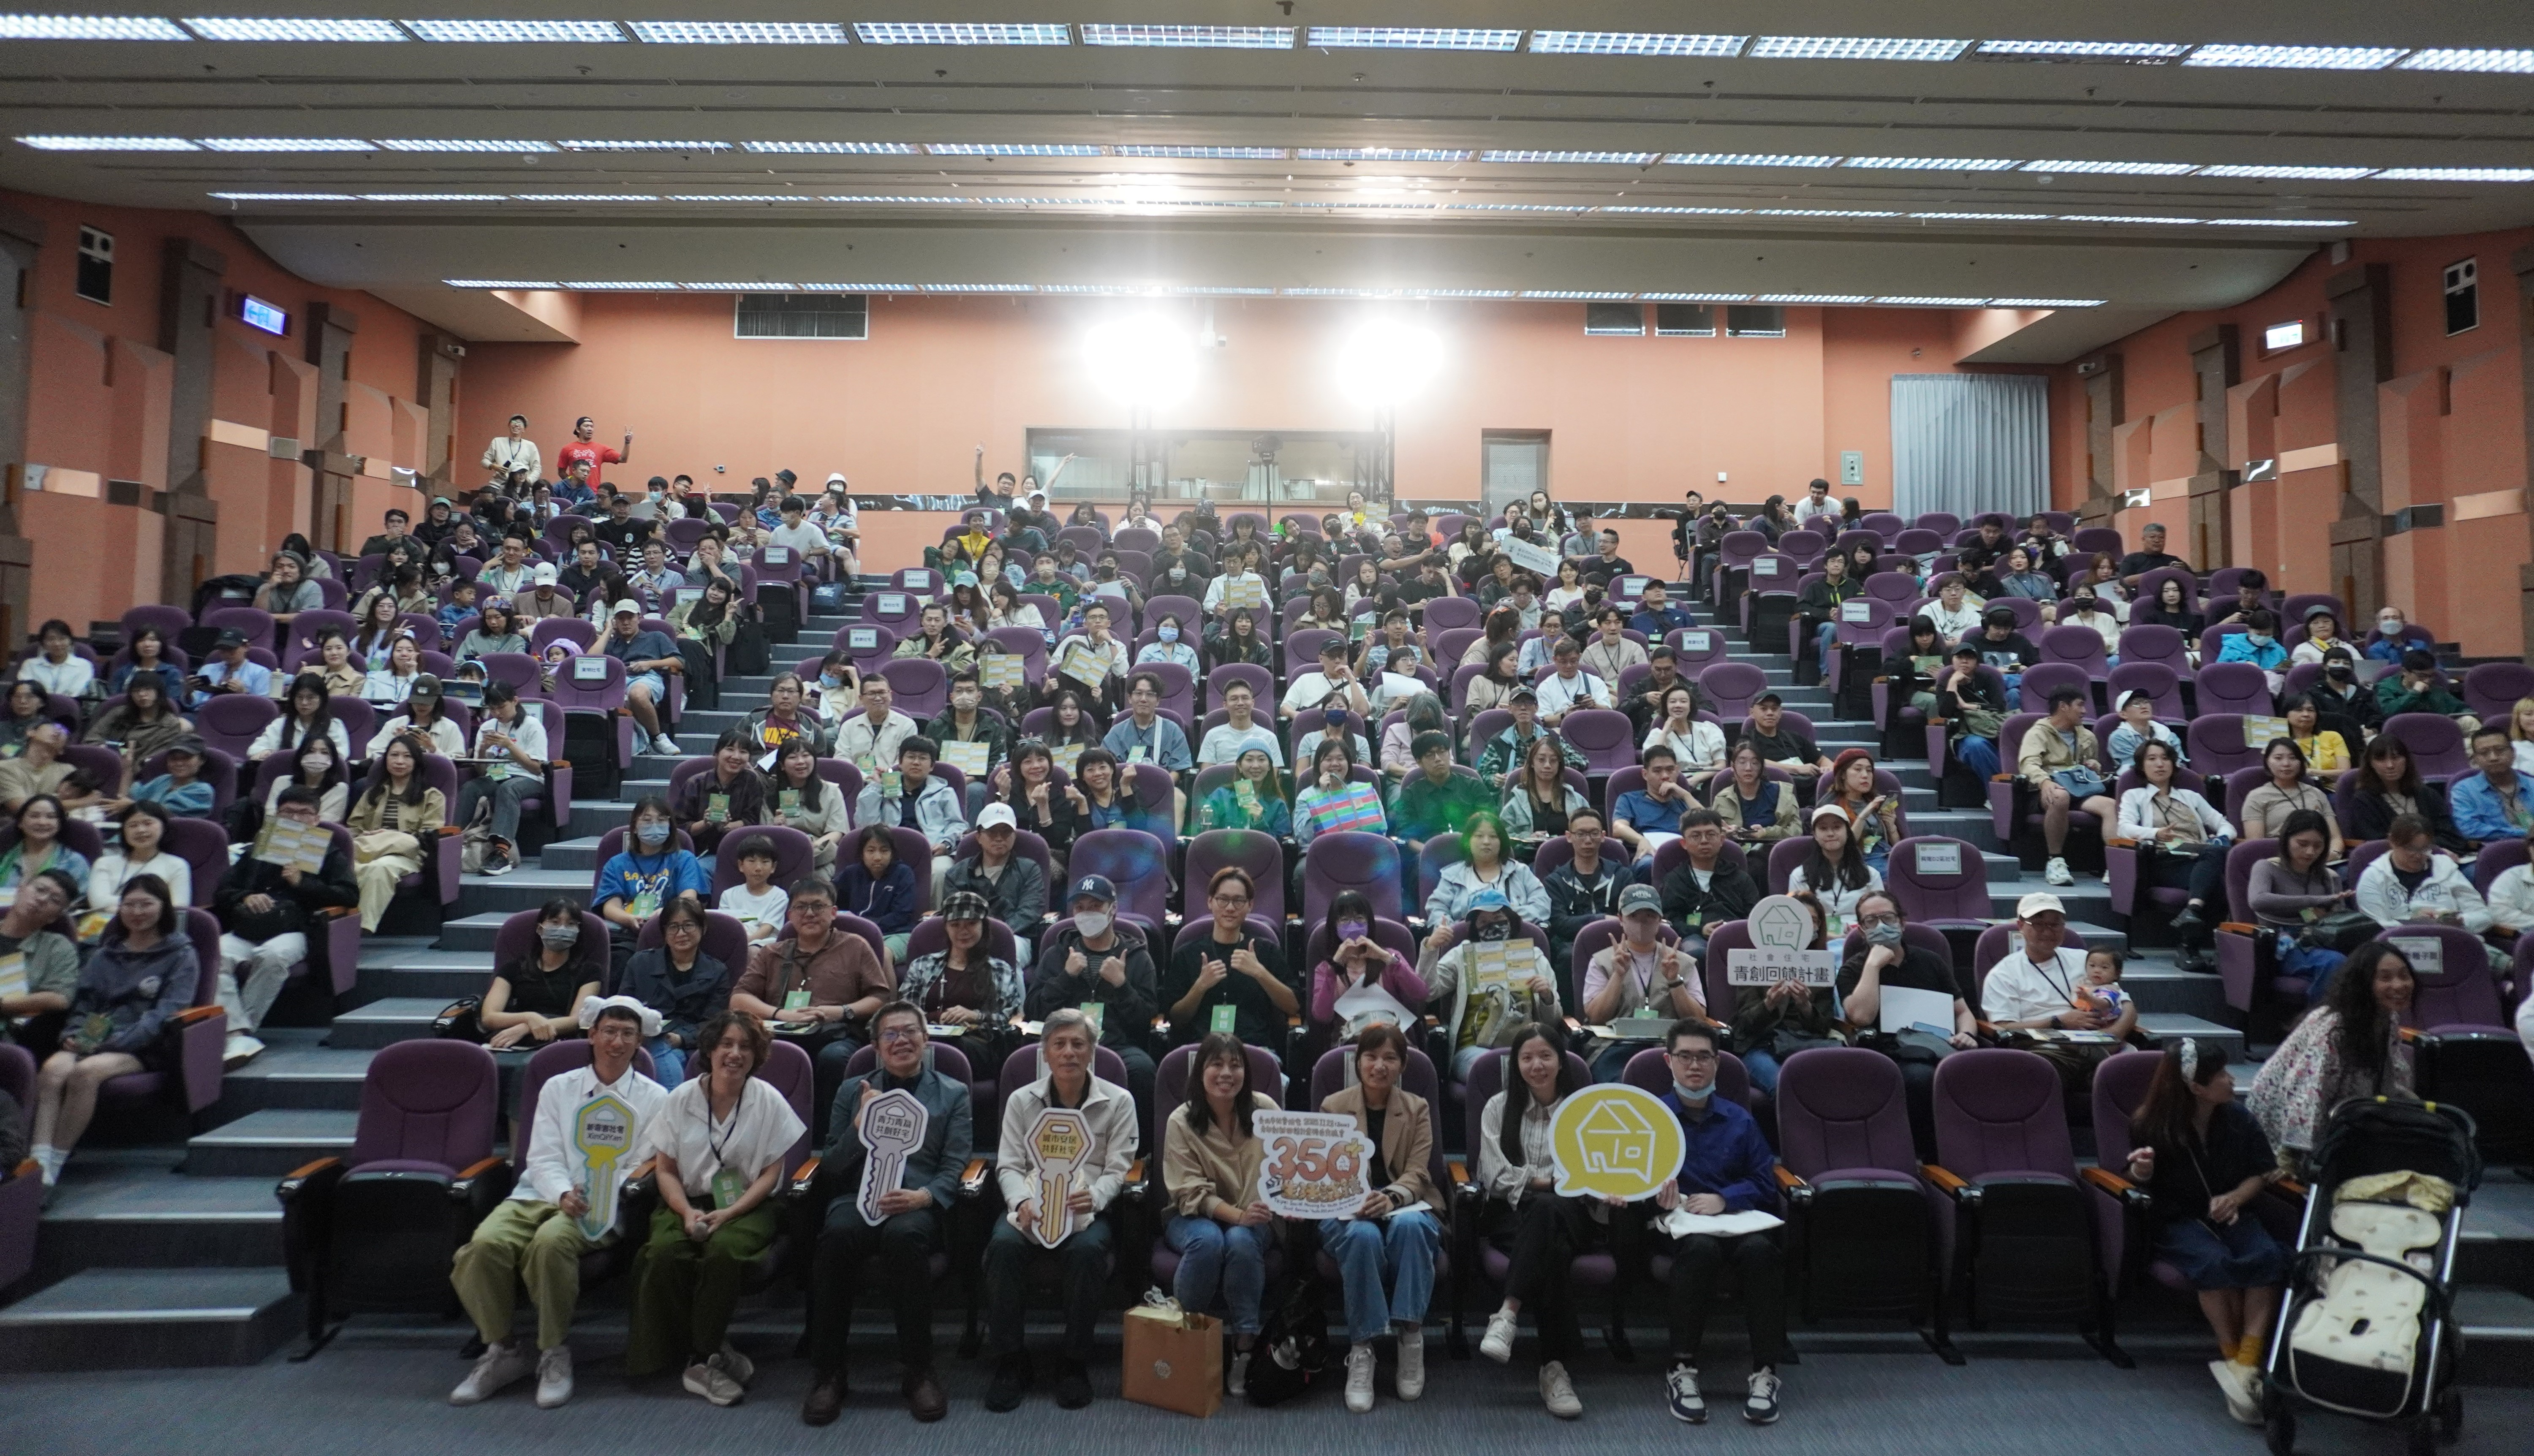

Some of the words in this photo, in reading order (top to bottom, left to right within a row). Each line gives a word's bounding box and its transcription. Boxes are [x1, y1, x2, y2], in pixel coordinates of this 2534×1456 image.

[1749, 953, 1811, 962] 社會住宅
[1733, 965, 1830, 983] 青創回饋計畫
